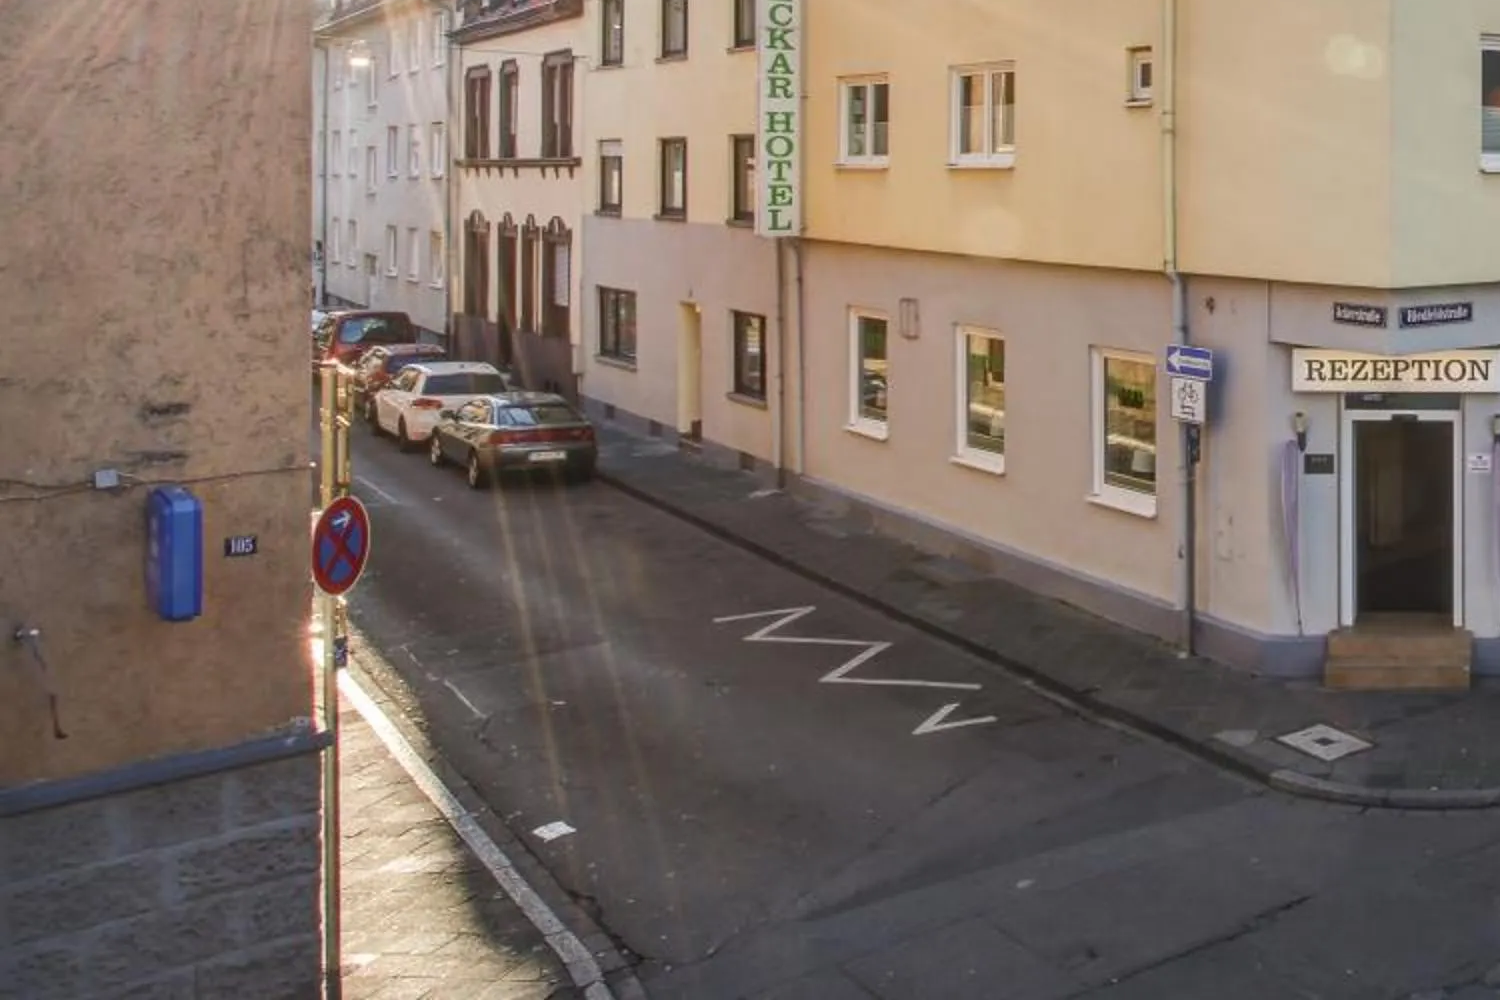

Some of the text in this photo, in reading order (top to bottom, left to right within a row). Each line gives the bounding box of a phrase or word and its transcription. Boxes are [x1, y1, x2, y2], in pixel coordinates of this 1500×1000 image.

[766, 111, 795, 230] HOTEL
[1304, 359, 1492, 382] REZEPTION
[231, 536, 253, 553] 105
